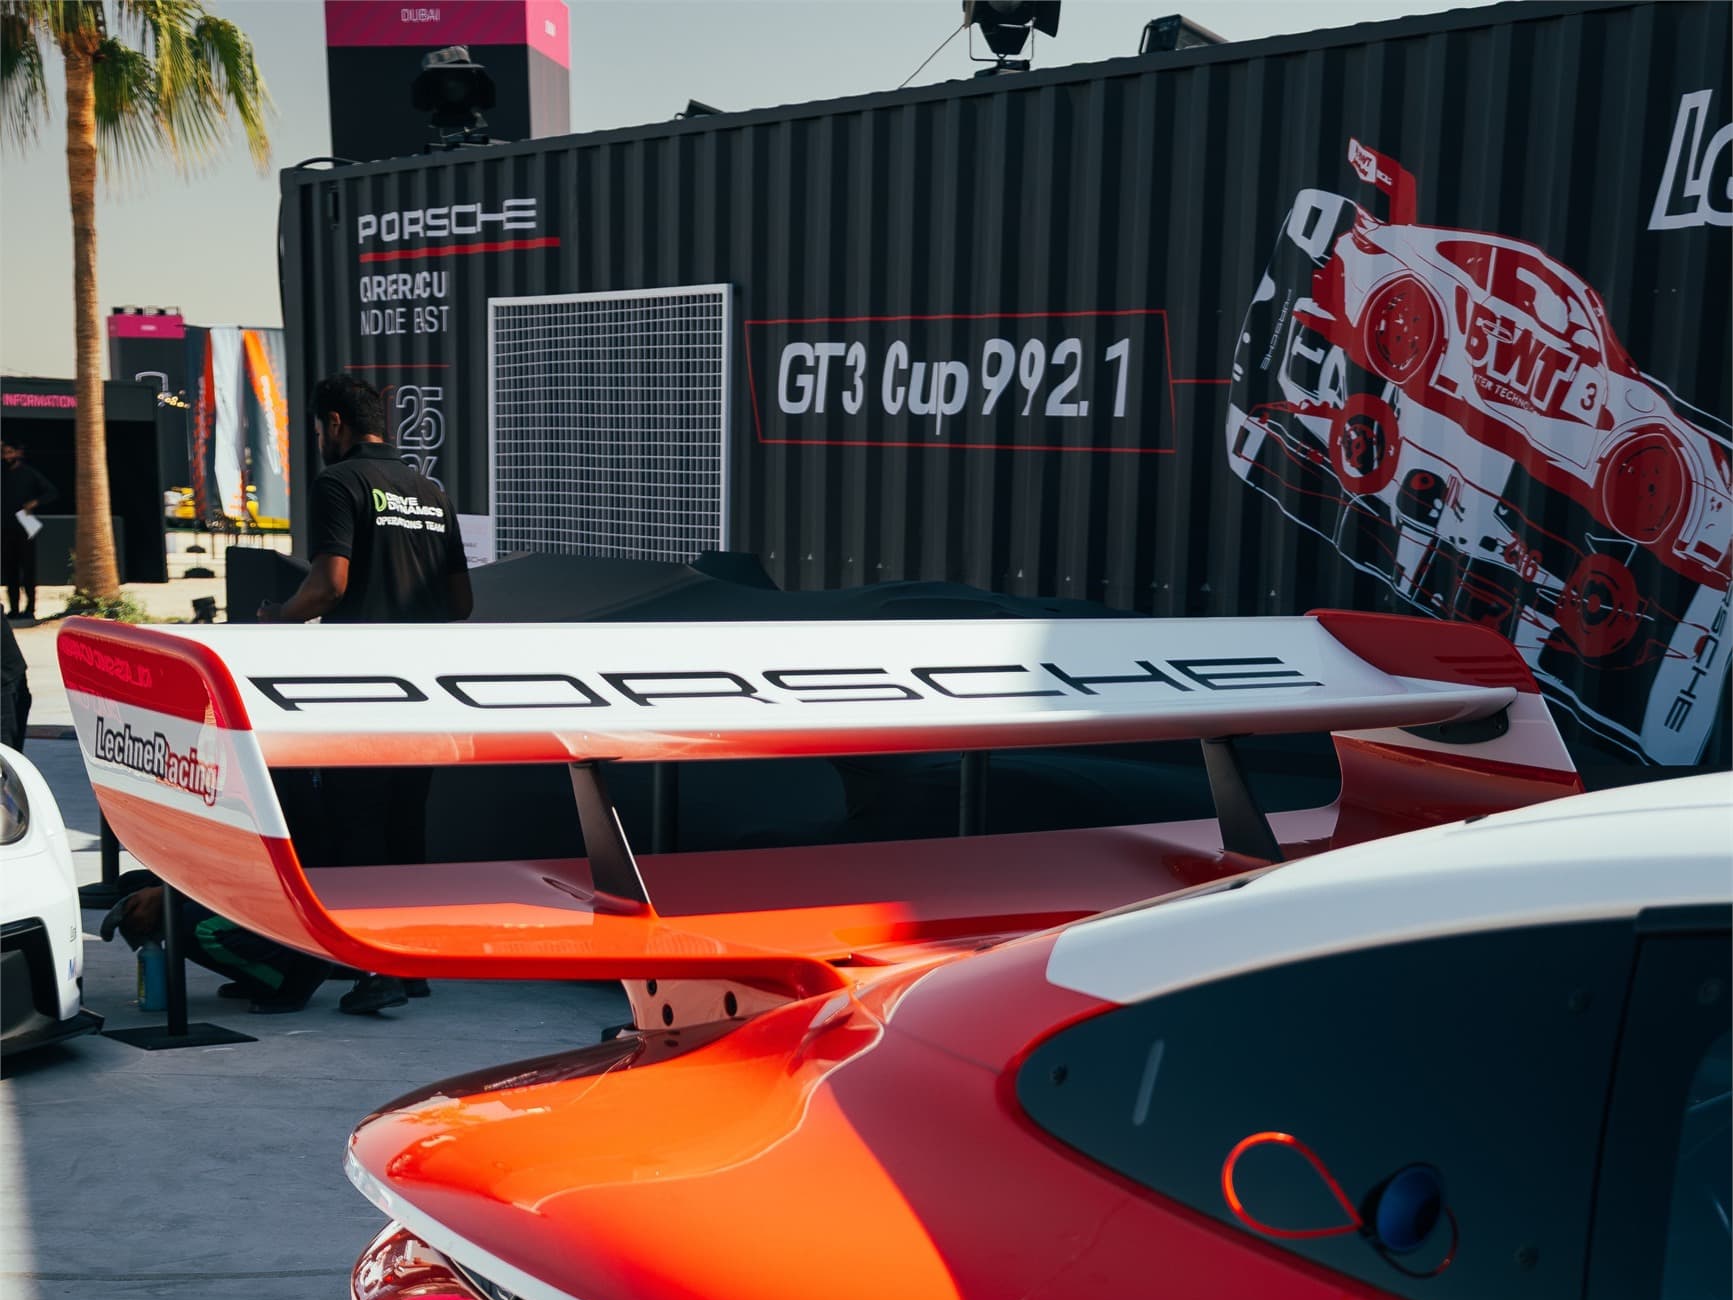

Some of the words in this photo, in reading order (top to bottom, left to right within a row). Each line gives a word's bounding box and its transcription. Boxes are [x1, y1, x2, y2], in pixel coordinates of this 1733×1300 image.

[400, 8, 441, 22] DUBAI
[357, 198, 537, 245] PORSCHE
[777, 340, 867, 415] GT3
[881, 339, 969, 436] Cup
[980, 337, 1130, 418] 992.1
[1580, 381, 1598, 411] 3
[246, 656, 1326, 712] PORSCHE
